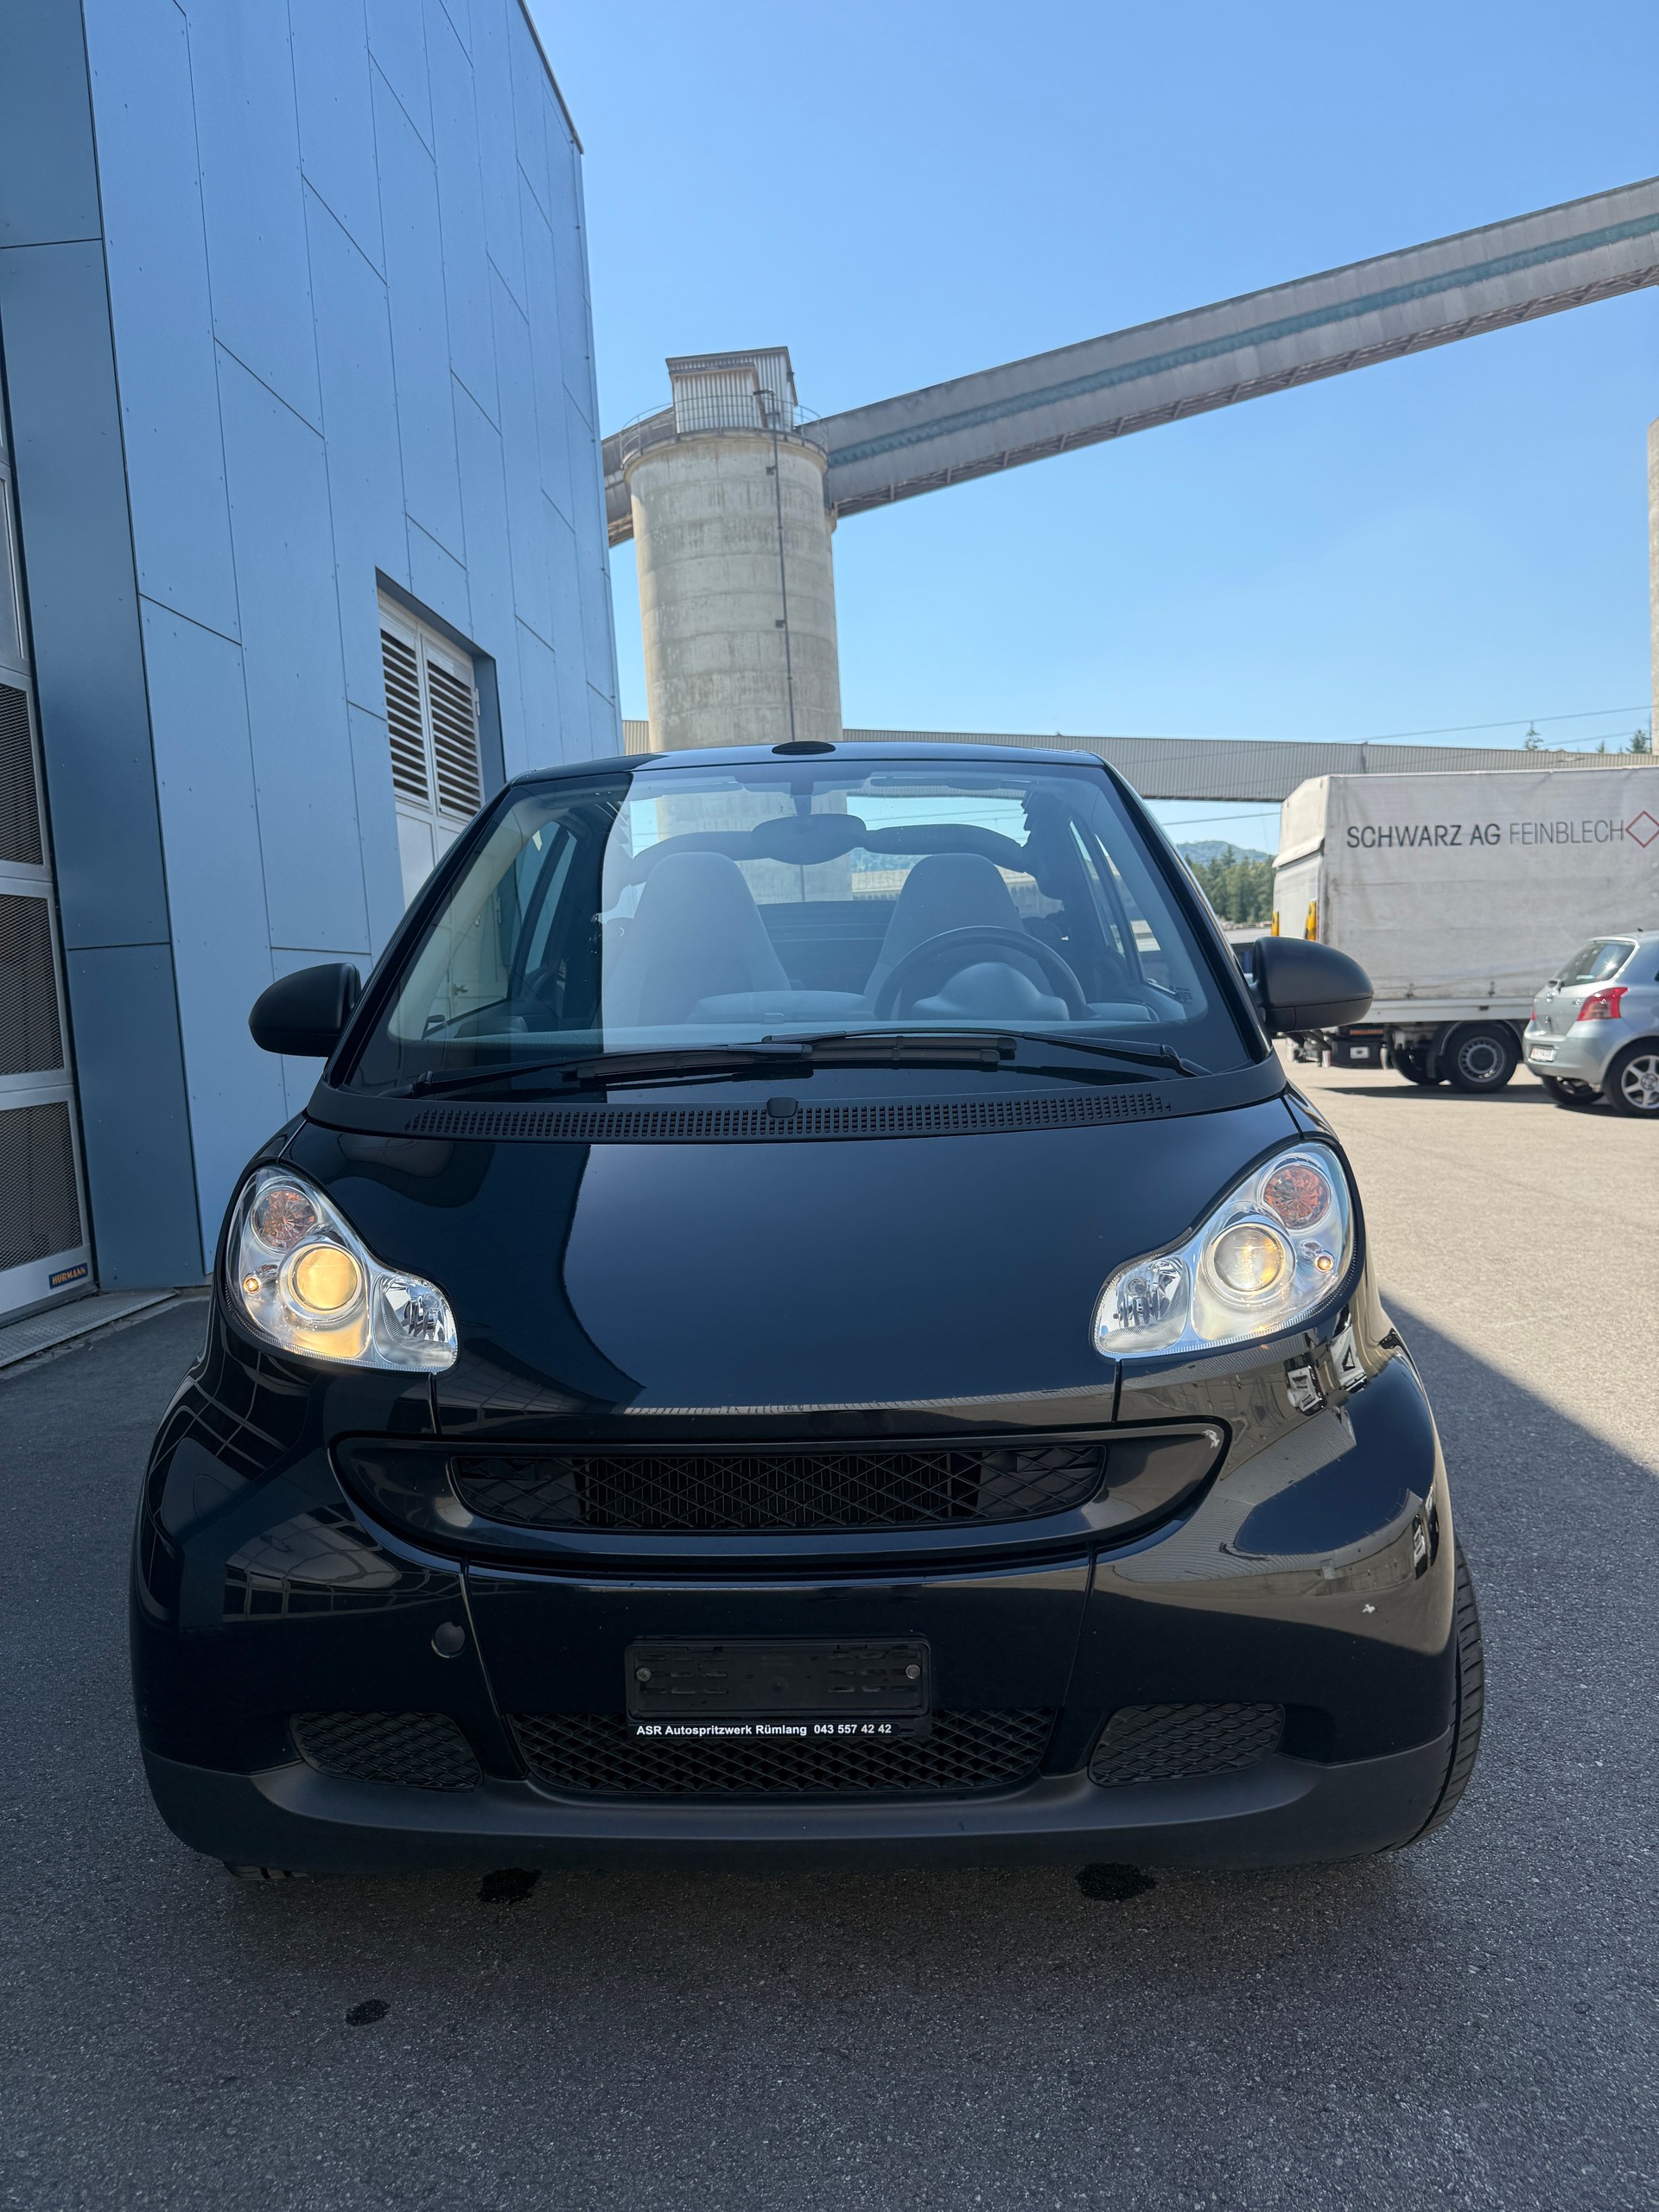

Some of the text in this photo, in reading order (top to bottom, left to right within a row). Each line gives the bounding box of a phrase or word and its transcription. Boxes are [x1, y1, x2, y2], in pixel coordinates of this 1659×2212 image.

[1346, 819, 1624, 849] SCHWARZ AG FEINBLECH
[636, 1724, 892, 1737] ASR Autospritzwerk Rümlang 043 557 42 42
